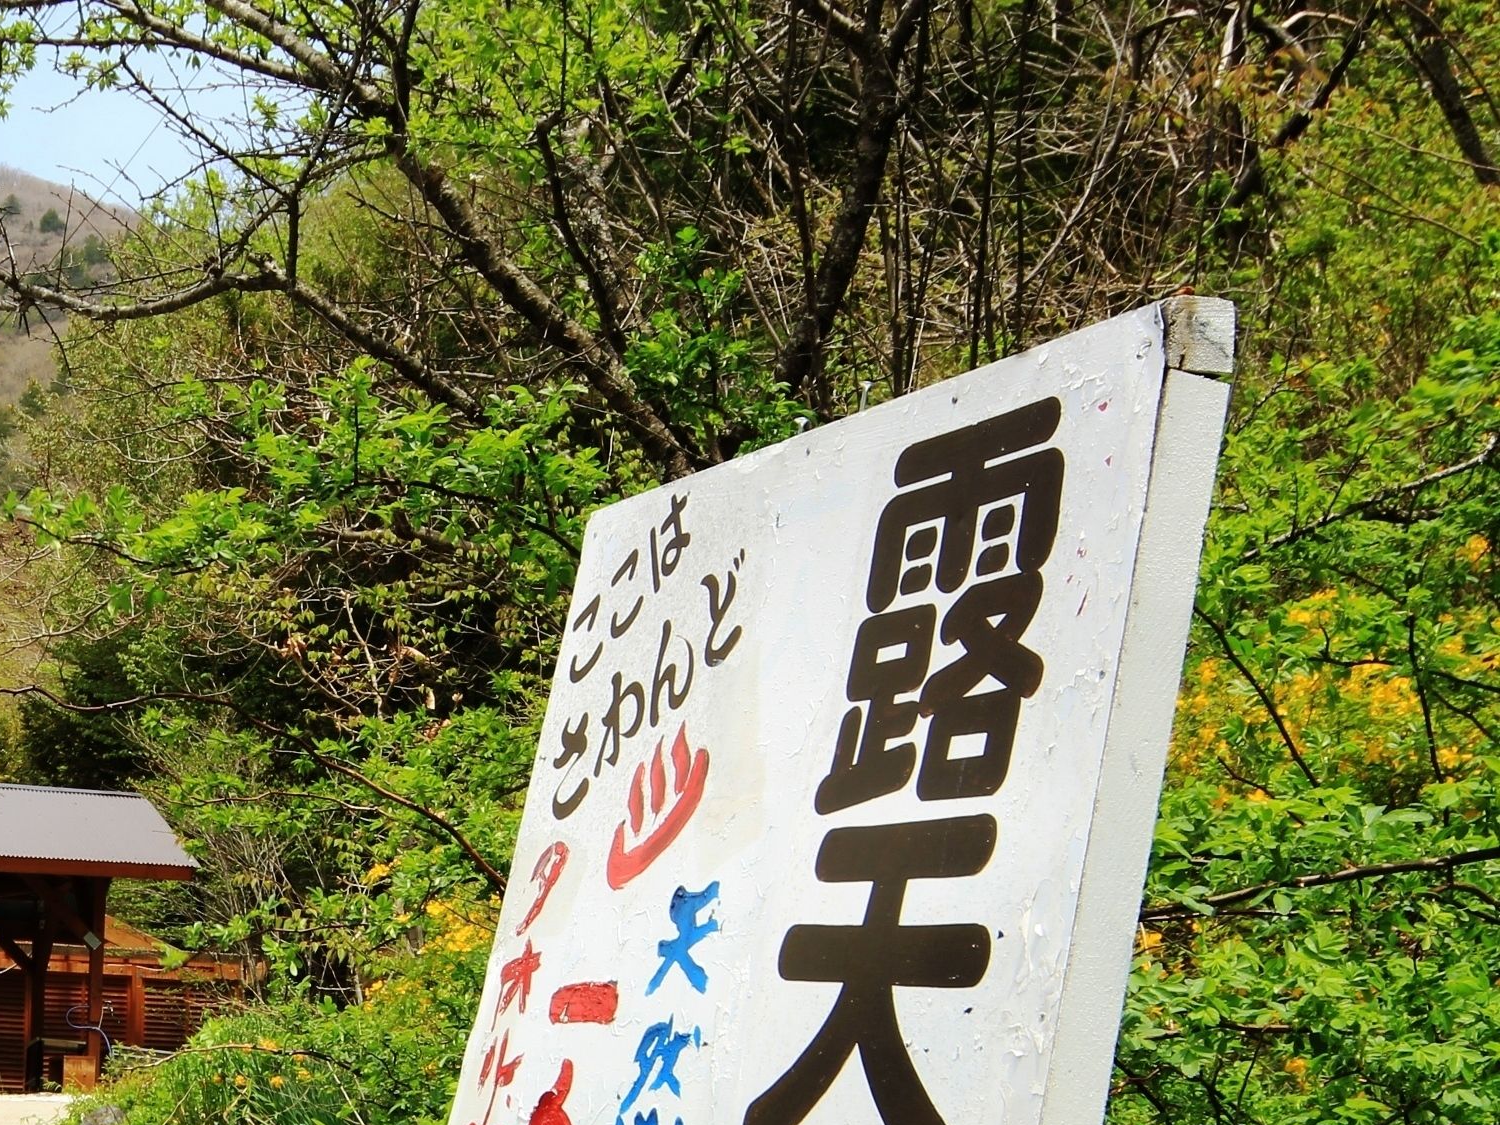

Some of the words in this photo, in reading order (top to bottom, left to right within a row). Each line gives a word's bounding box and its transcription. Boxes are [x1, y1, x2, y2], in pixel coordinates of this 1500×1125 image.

[553, 548, 746, 820] さわんど
[570, 493, 692, 684] ここは
